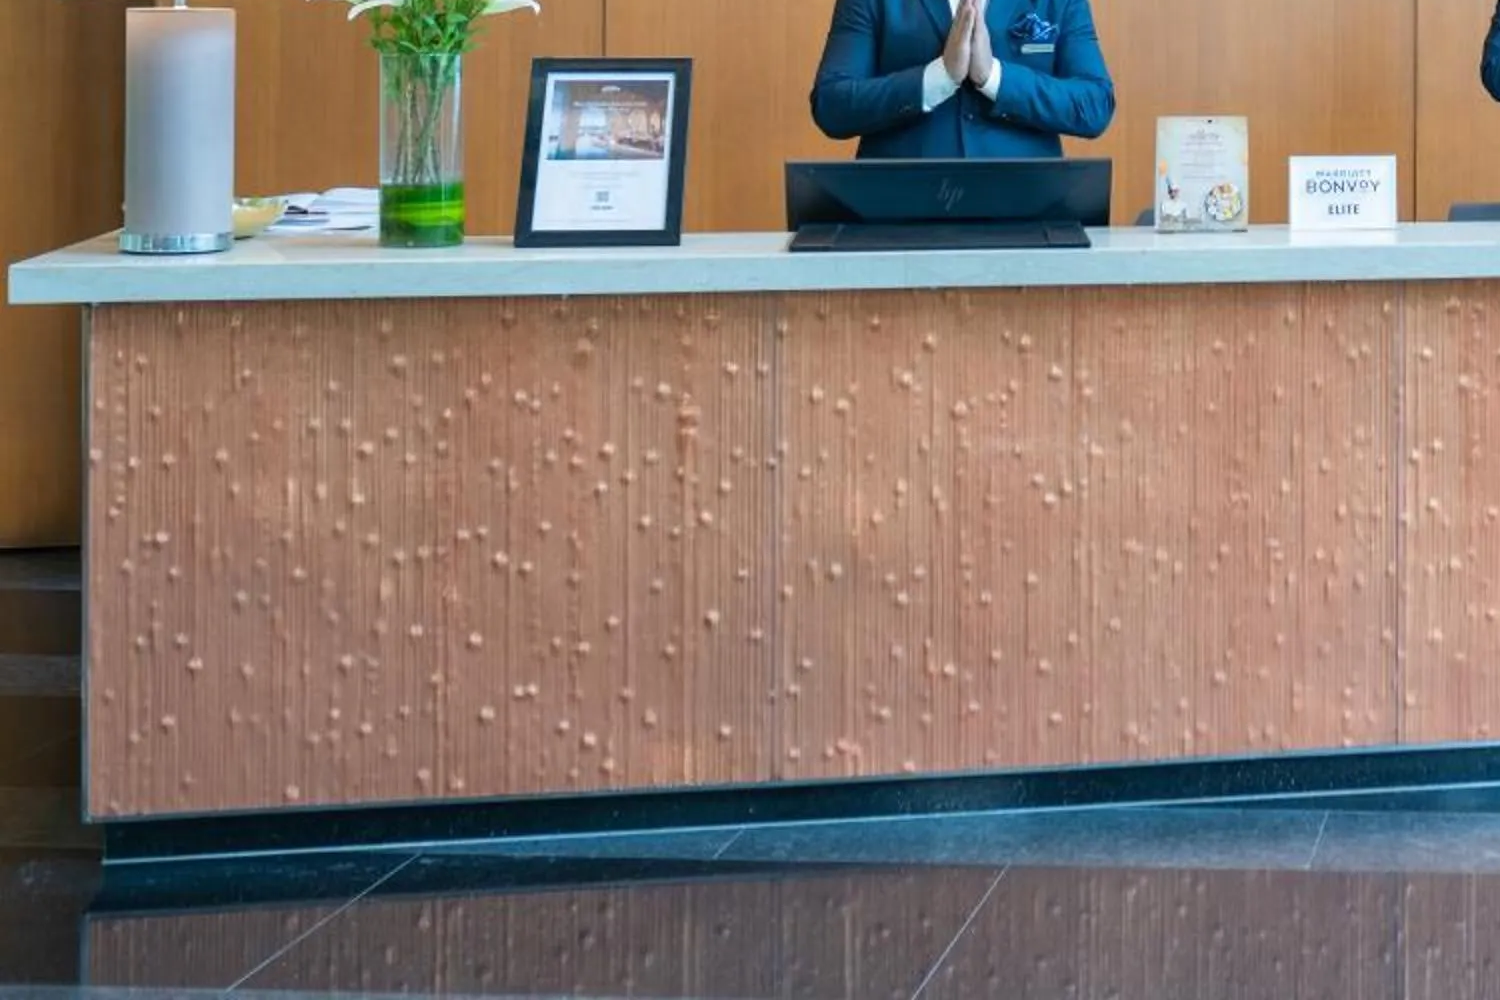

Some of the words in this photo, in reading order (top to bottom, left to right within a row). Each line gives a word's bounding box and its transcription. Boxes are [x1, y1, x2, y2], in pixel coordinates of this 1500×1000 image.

[1306, 179, 1381, 194] BONVOY
[936, 178, 963, 211] hp
[1327, 203, 1361, 215] ELITE
